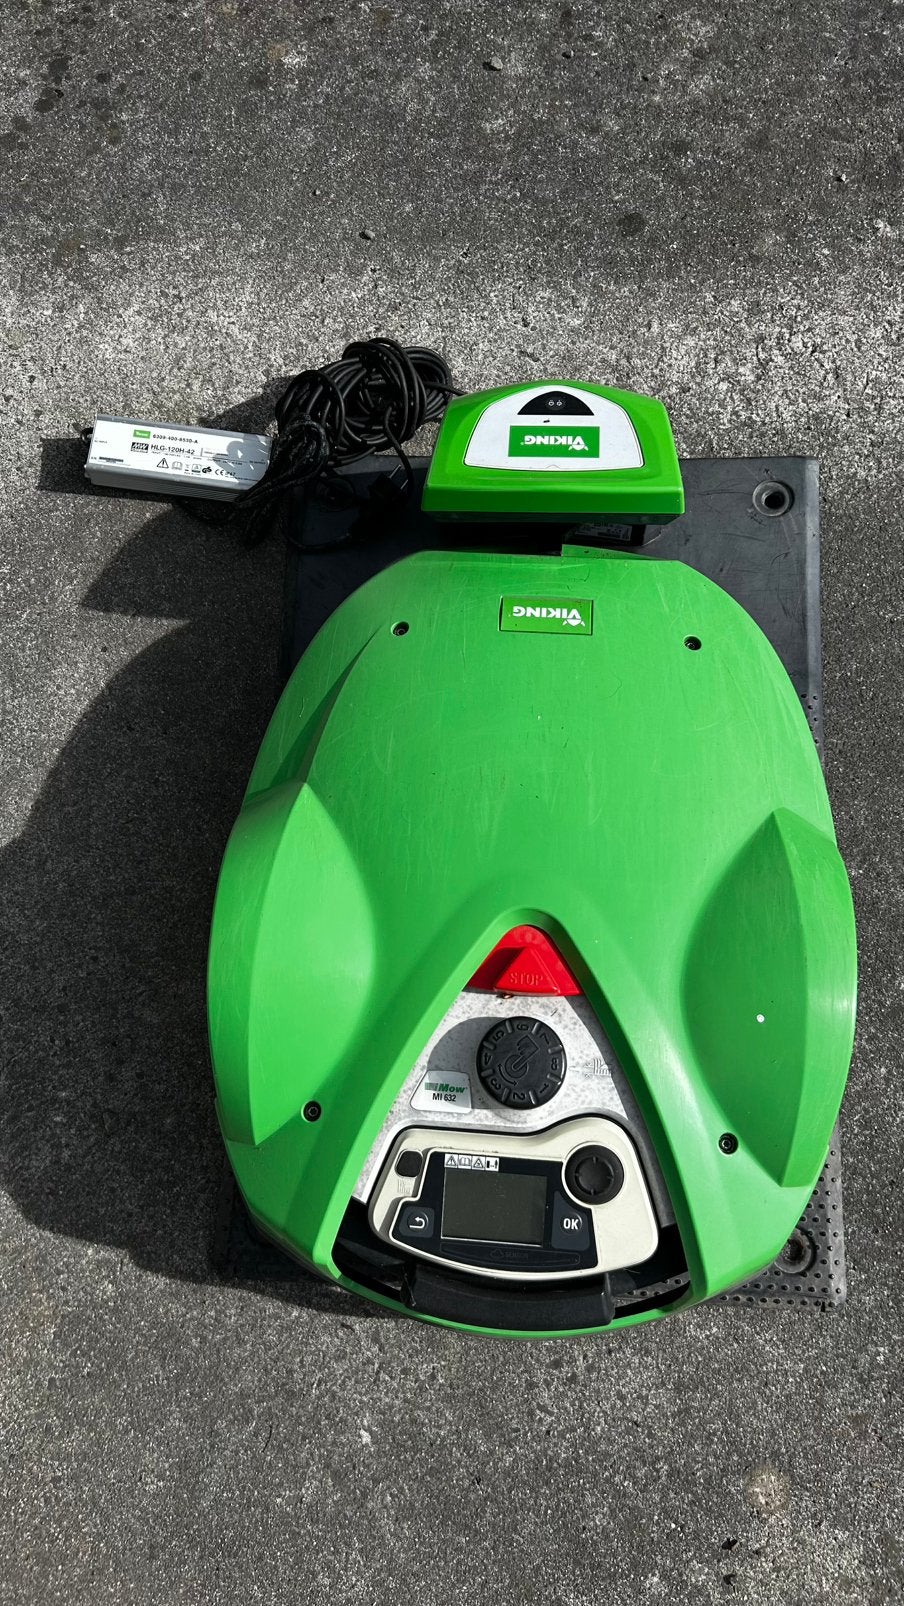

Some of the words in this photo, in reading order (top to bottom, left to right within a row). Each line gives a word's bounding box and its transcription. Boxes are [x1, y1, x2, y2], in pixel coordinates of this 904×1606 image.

[523, 435, 585, 446] VIKING
[150, 444, 195, 455] HLG-120H-42
[512, 606, 582, 620] VIKING
[510, 971, 543, 986] STOP
[432, 1093, 442, 1101] MI
[443, 1094, 457, 1102] 632
[563, 1218, 579, 1230] OK
